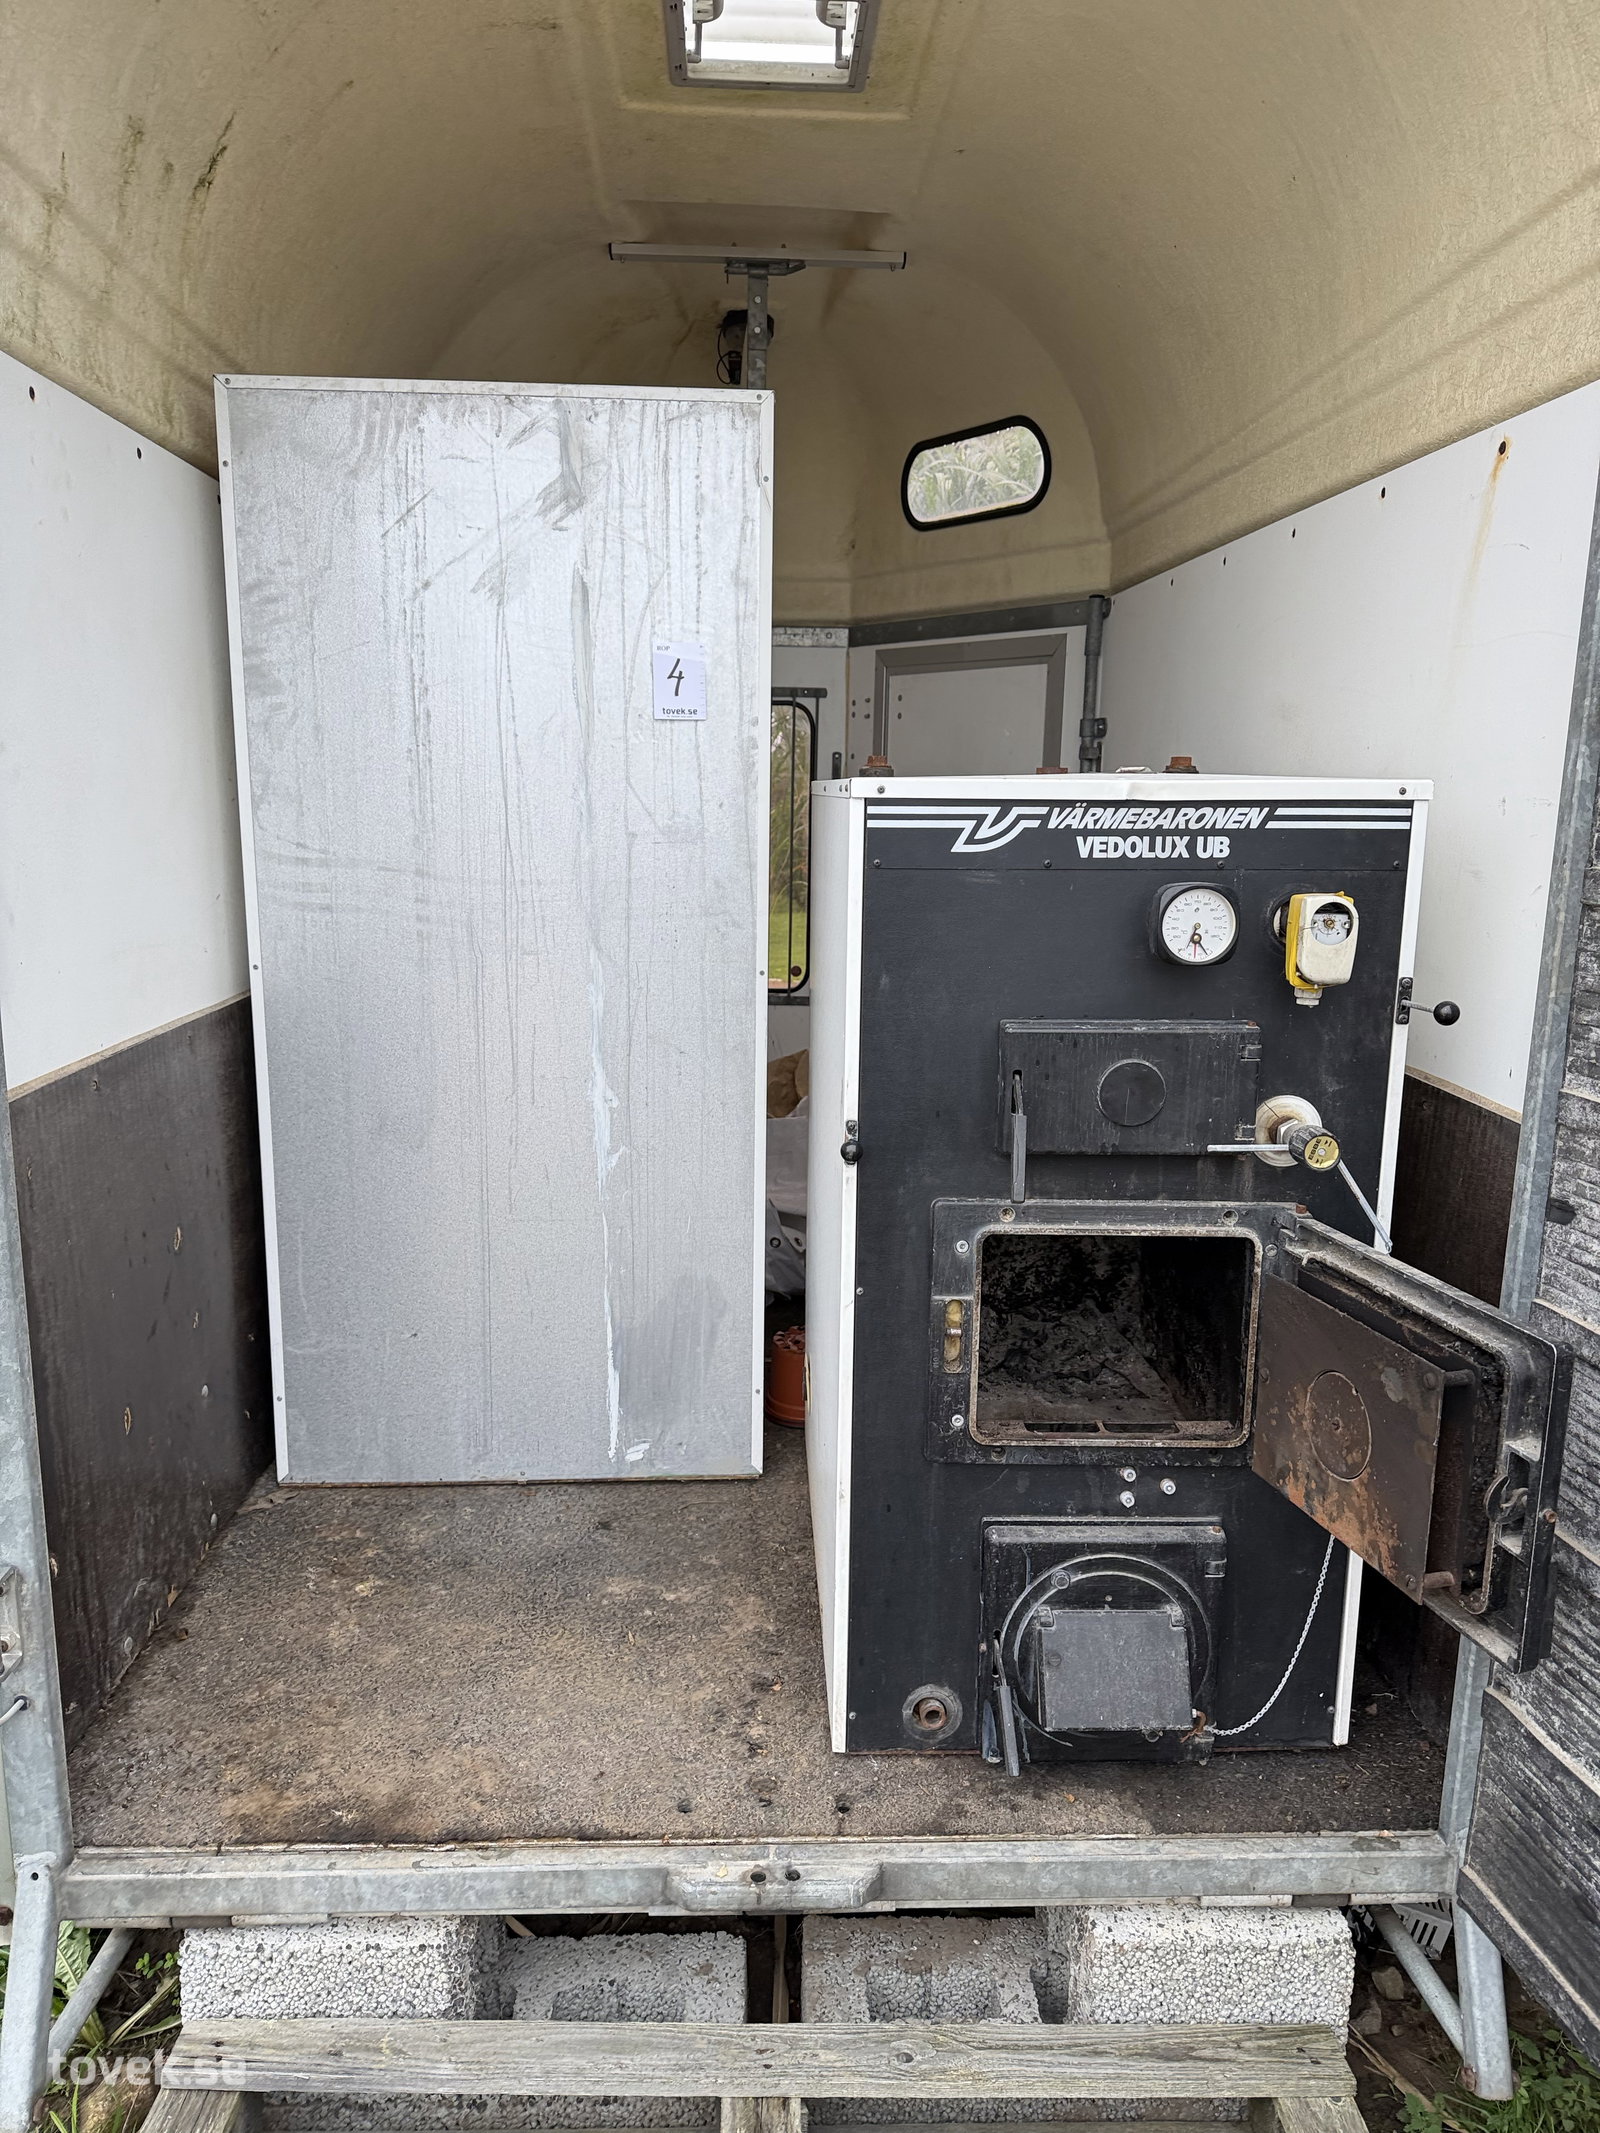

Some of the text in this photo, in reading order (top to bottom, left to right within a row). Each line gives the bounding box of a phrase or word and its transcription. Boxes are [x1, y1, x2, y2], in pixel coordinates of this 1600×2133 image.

[667, 658, 685, 696] 4
[662, 707, 698, 715] tovek.se
[1047, 802, 1270, 830] VÄRMEBARONEN
[1076, 835, 1231, 858] VEDOLUX UB
